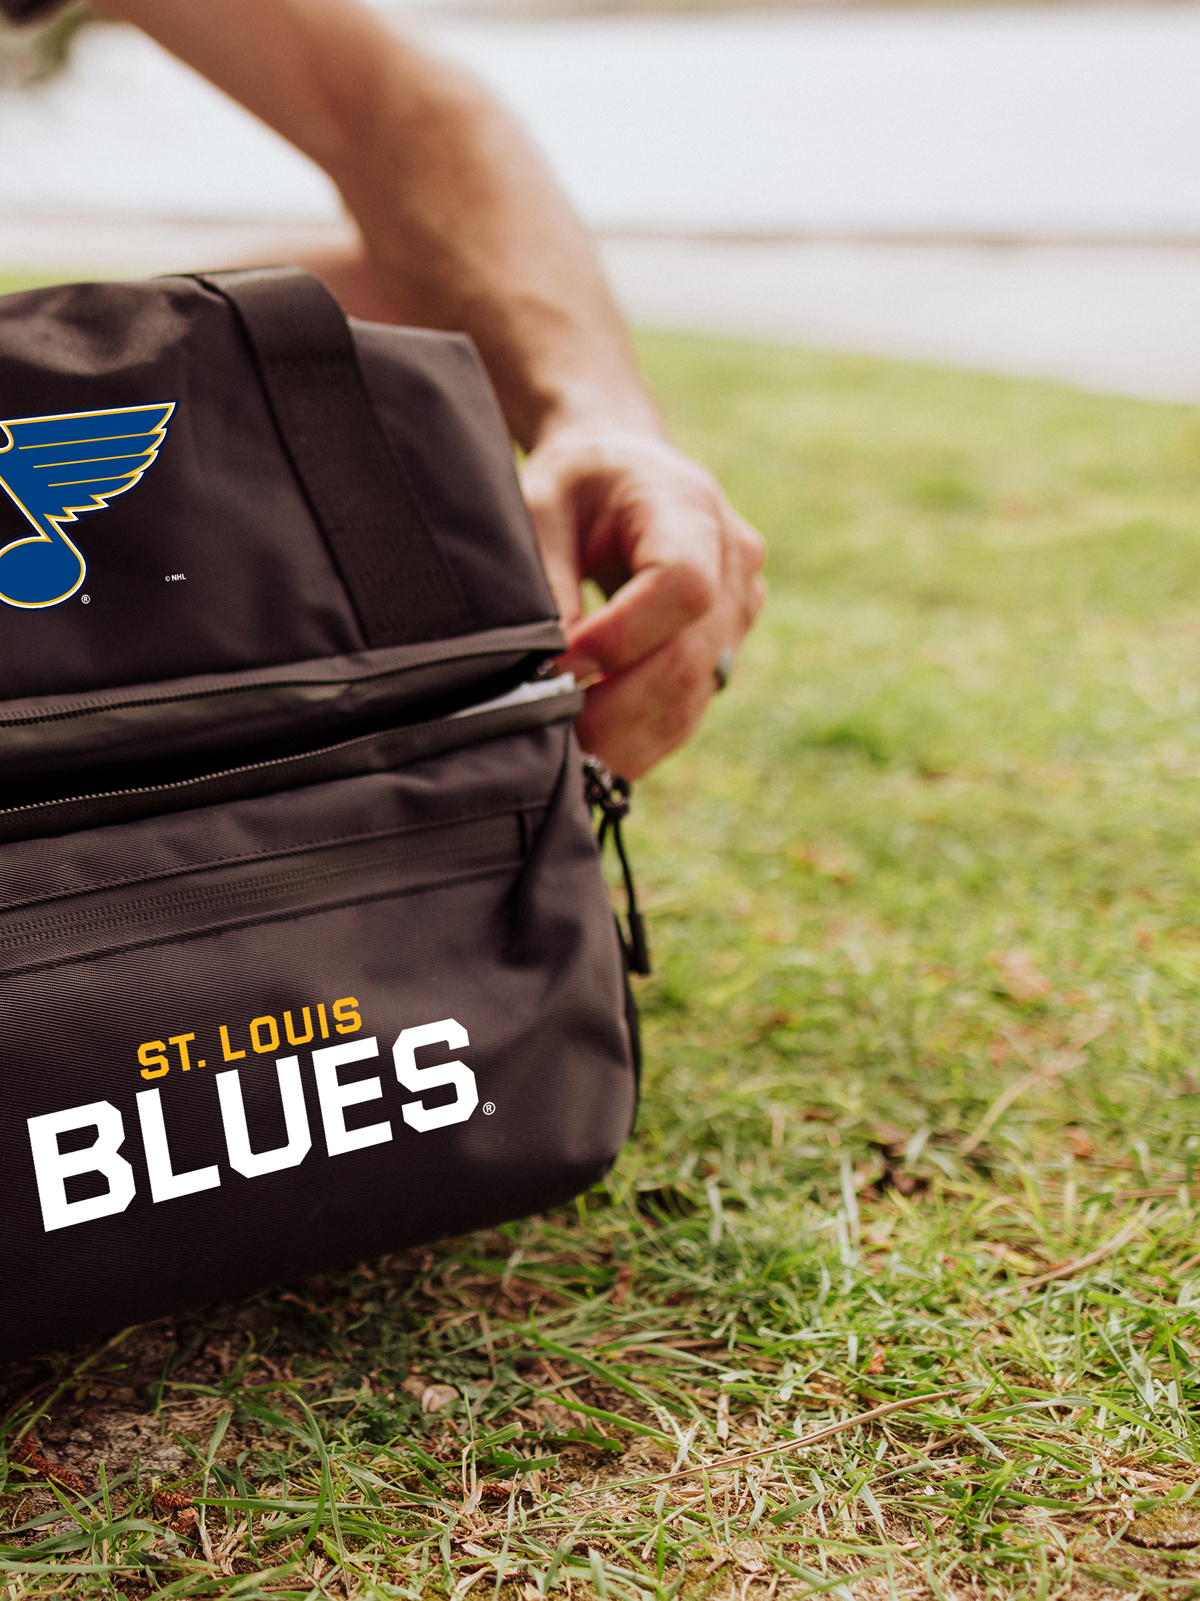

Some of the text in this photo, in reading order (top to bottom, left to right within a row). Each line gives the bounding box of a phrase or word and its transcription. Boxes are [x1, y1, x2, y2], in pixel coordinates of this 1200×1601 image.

[171, 573, 187, 581] NHL
[136, 996, 363, 1081] ST. LOUIS
